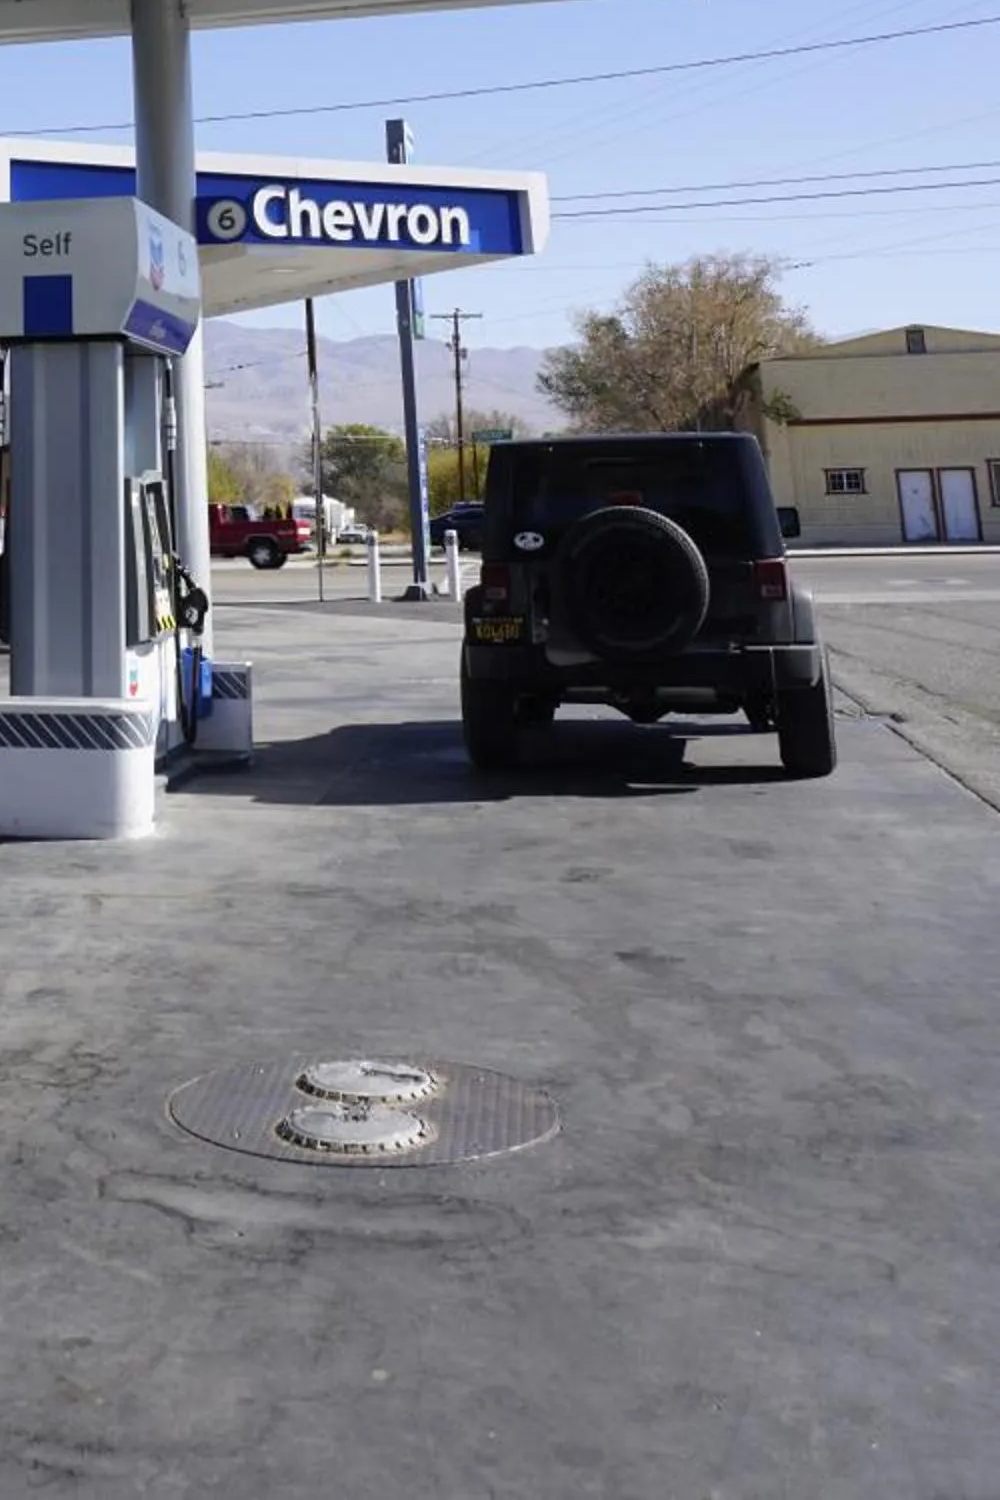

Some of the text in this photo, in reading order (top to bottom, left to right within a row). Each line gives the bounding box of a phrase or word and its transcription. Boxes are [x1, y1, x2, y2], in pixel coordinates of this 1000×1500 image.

[218, 208, 235, 231] 6
[253, 184, 470, 246] Chevron
[23, 232, 71, 256] Self
